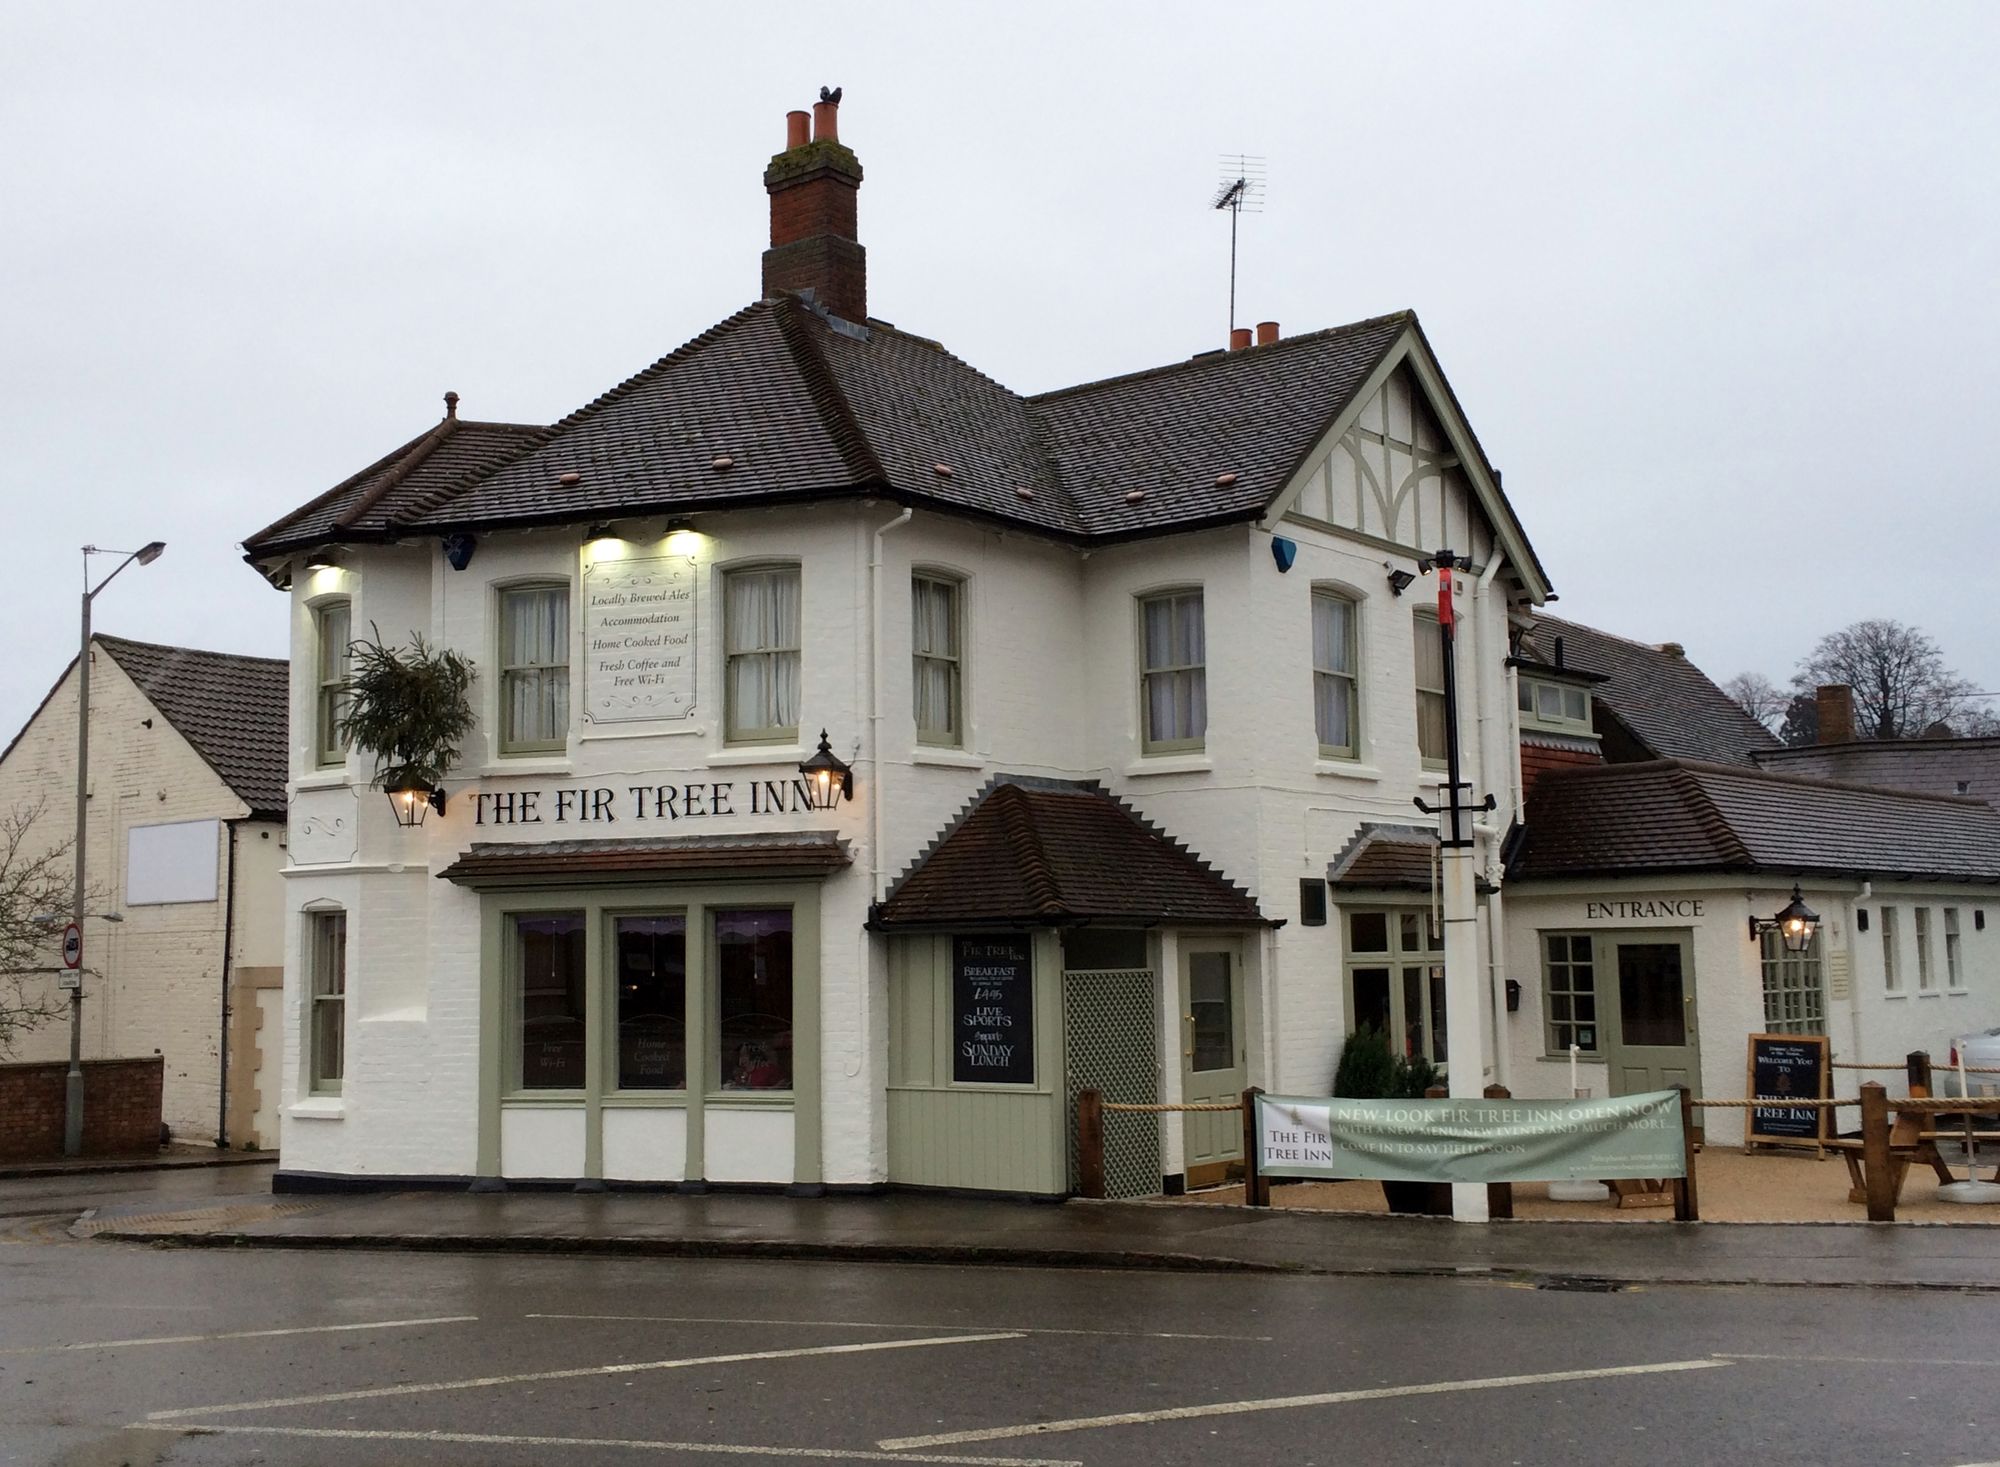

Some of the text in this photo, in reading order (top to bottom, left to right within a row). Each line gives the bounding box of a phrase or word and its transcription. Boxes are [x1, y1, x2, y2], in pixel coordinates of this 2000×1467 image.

[592, 589, 690, 606] Locally Brewed Ales
[600, 613, 680, 627] Accommodation
[593, 633, 689, 651] Home Cooked Food
[600, 657, 680, 672] Fresh Coffee and
[614, 673, 665, 687] Free Wi-Fi
[469, 778, 814, 826] THE FIR TREE INN
[1587, 900, 1705, 919] ENTRANCE
[963, 966, 1017, 976] BREAKFAST
[976, 1007, 1004, 1016] LIVE
[963, 1014, 1012, 1027] SPORTS
[962, 1041, 1014, 1057] SUNDAY
[971, 1055, 1009, 1067] LUNCH
[1796, 1057, 1813, 1066] YOU
[1338, 1101, 1674, 1123] NEW-LOOK FIR TREE INN OPEN NOW
[1756, 1107, 1816, 1121] TREE INN
[1338, 1123, 1372, 1134] WITH
[1387, 1125, 1416, 1135] NEW
[1463, 1126, 1492, 1136] NEW
[1497, 1125, 1545, 1136] EVENTS
[1549, 1123, 1578, 1134] AND
[1582, 1122, 1623, 1133] MUCH
[1270, 1130, 1327, 1144] THE FIR
[1264, 1147, 1331, 1161] TREE INN
[1340, 1142, 1376, 1153] COME
[1379, 1143, 1393, 1153] IN
[1395, 1143, 1414, 1153] TO
[1416, 1143, 1439, 1154] SAY
[1443, 1144, 1484, 1154] HELLO
